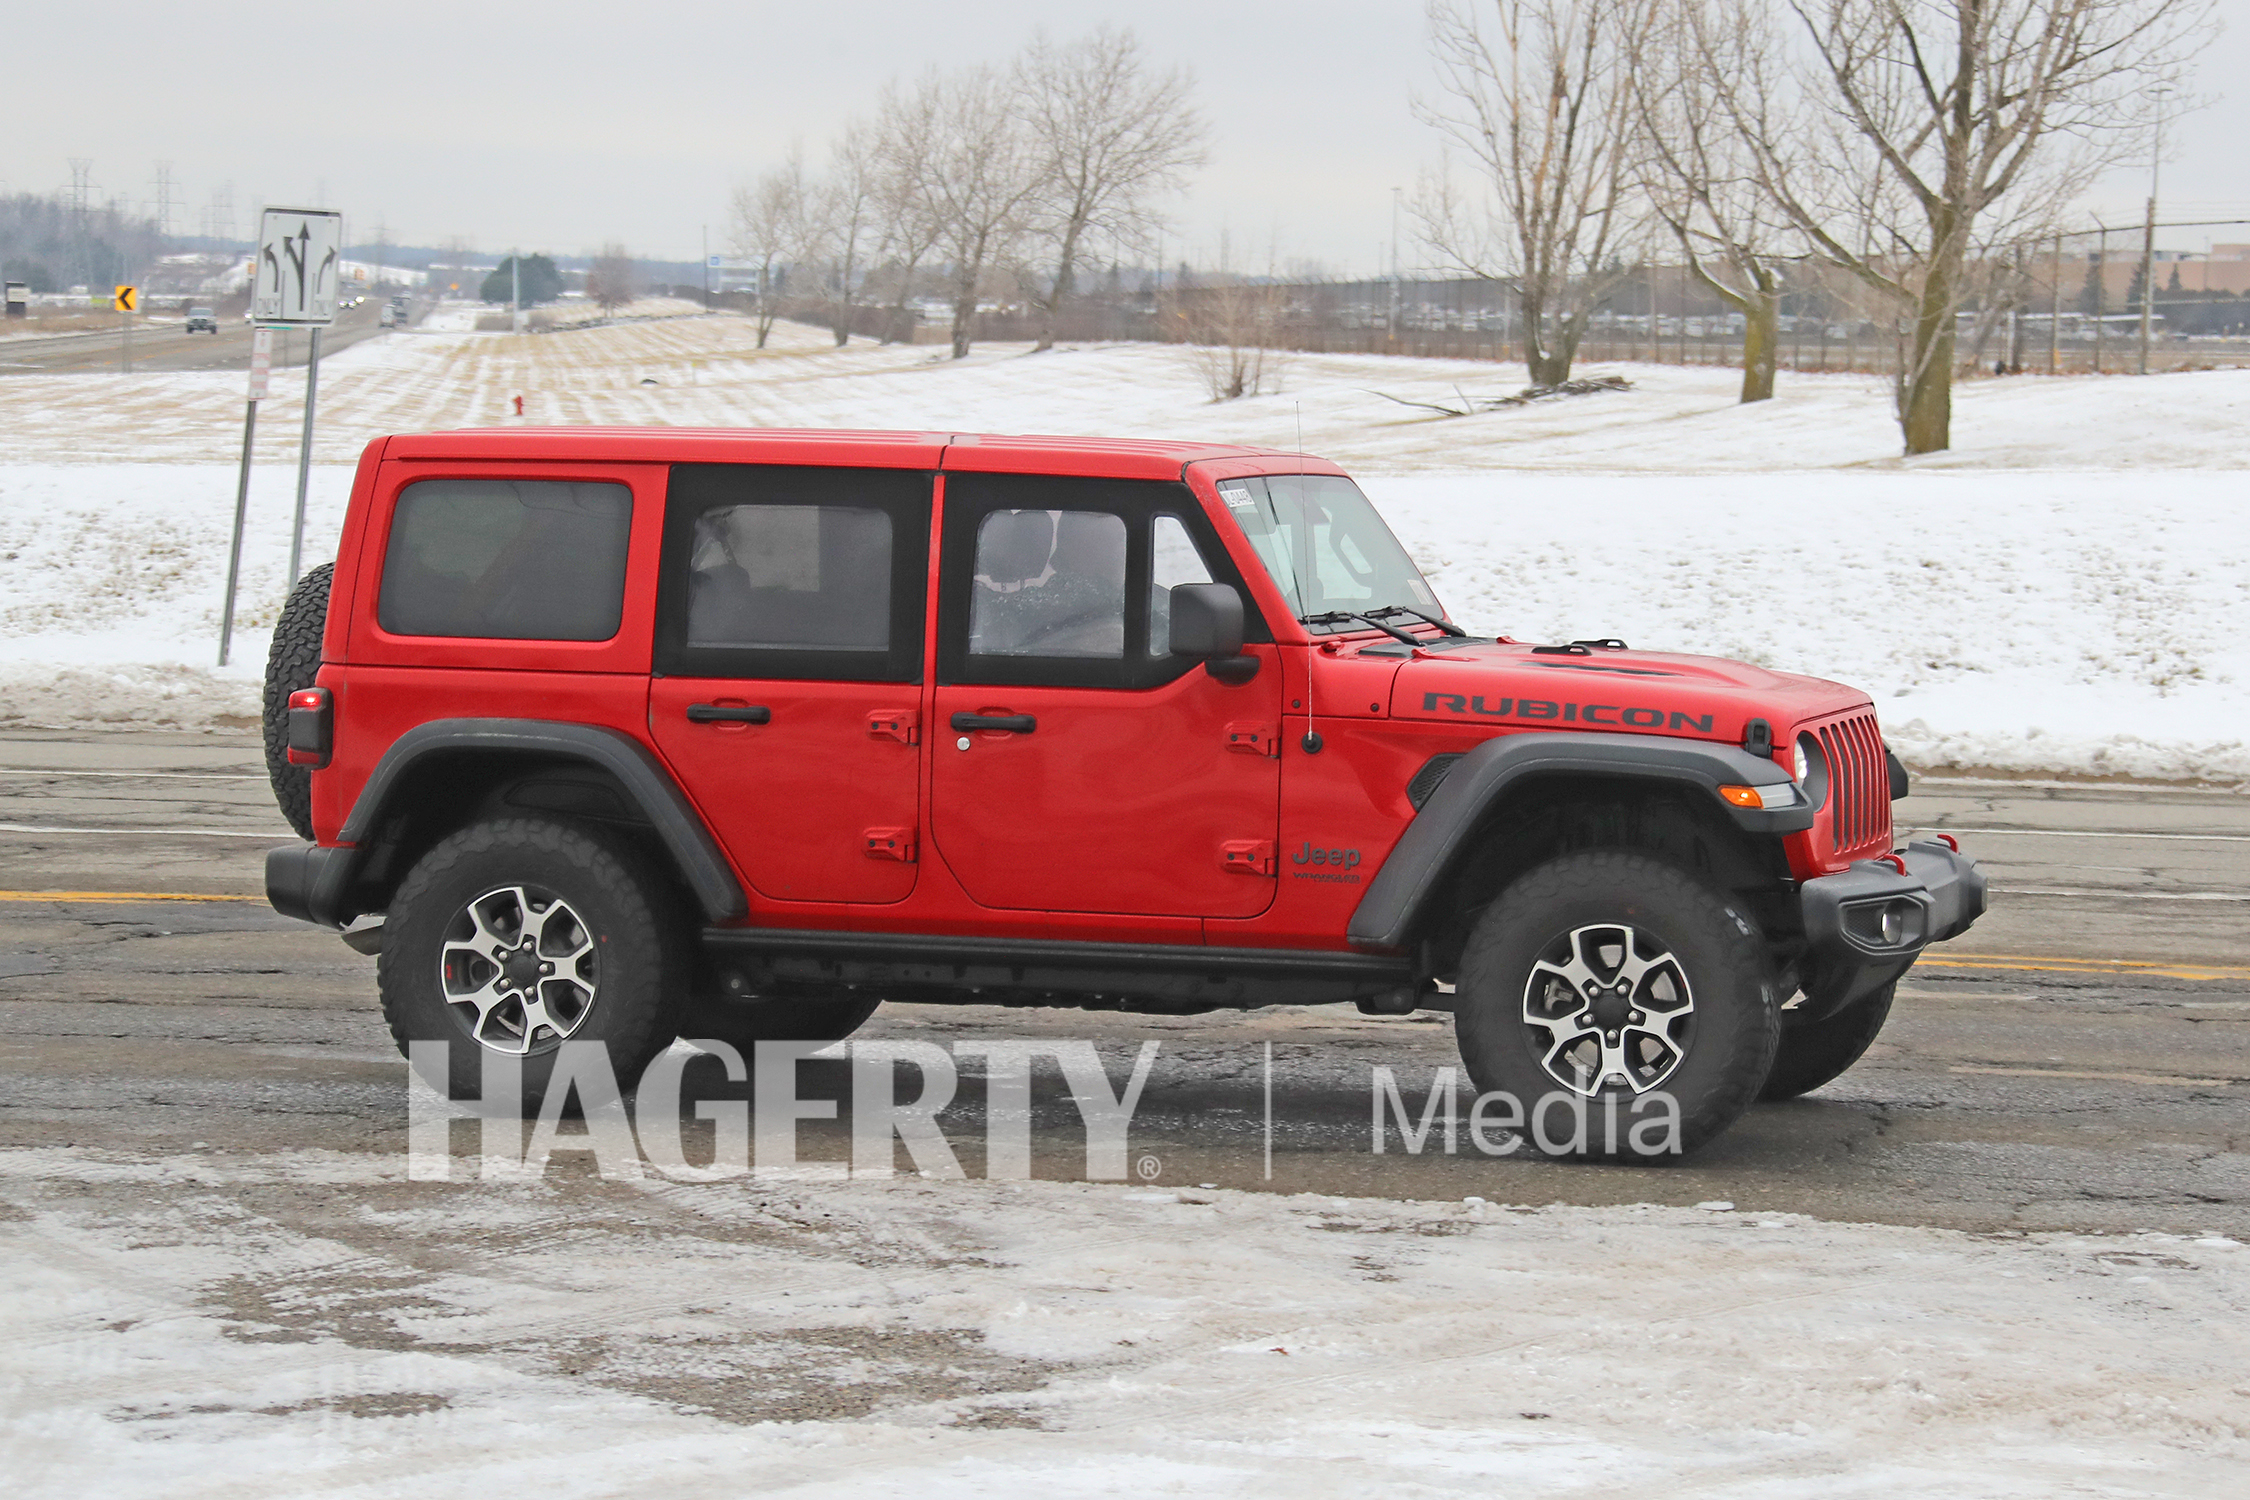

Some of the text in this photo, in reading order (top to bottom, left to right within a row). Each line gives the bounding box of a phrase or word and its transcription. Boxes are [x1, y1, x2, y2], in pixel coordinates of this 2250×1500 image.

[1422, 692, 1713, 732] RUBICON
[1292, 842, 1361, 870] Jeep
[1293, 872, 1360, 880] WRANGLER
